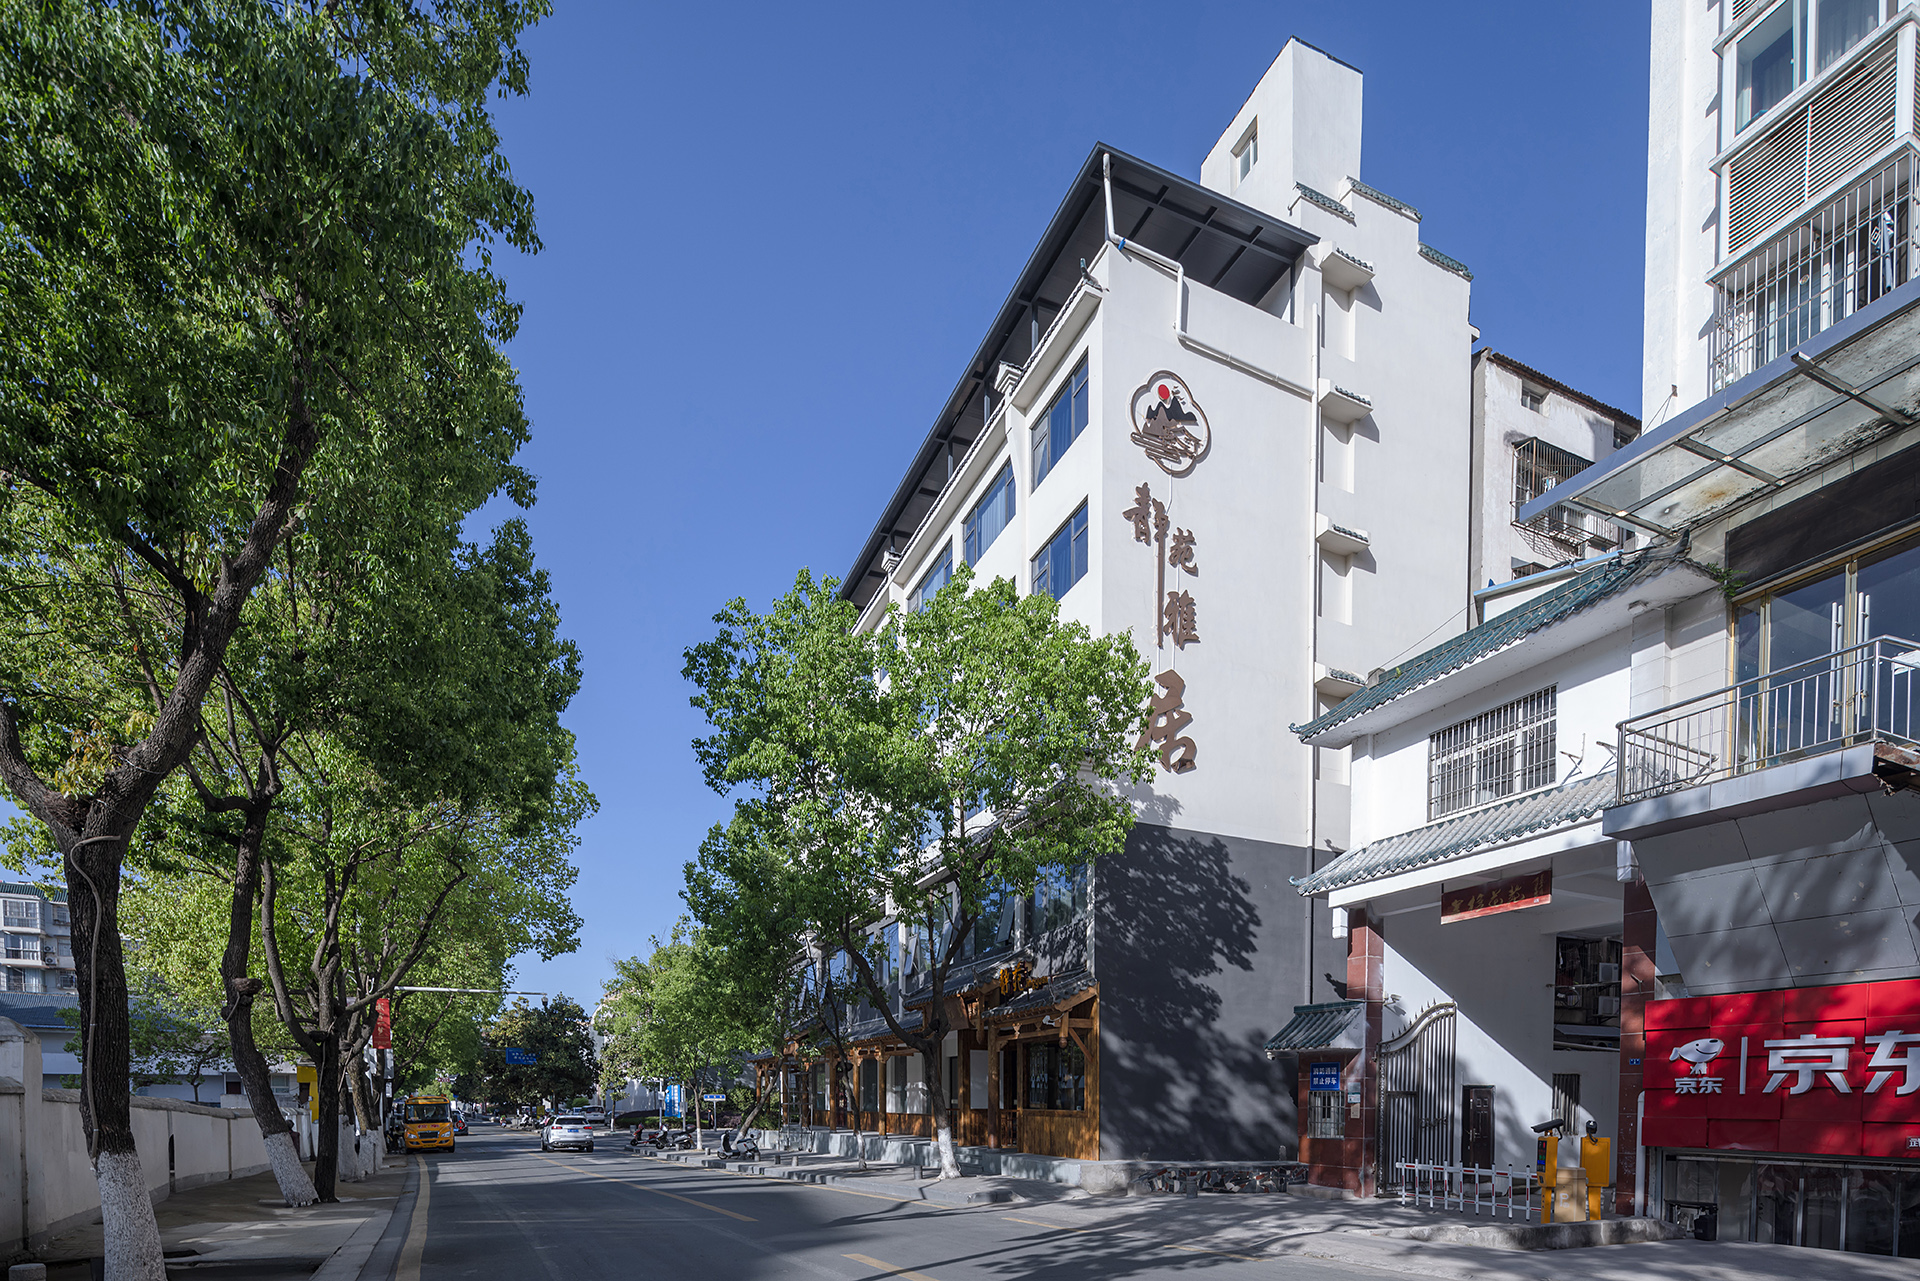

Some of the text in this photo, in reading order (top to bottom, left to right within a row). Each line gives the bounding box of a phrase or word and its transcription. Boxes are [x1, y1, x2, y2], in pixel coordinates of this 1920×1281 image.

[1762, 1030, 1920, 1096] 京东
[1313, 1067, 1337, 1075] 消防通道
[1313, 1077, 1337, 1085] 禁止停车
[1674, 1077, 1725, 1094] 京东
